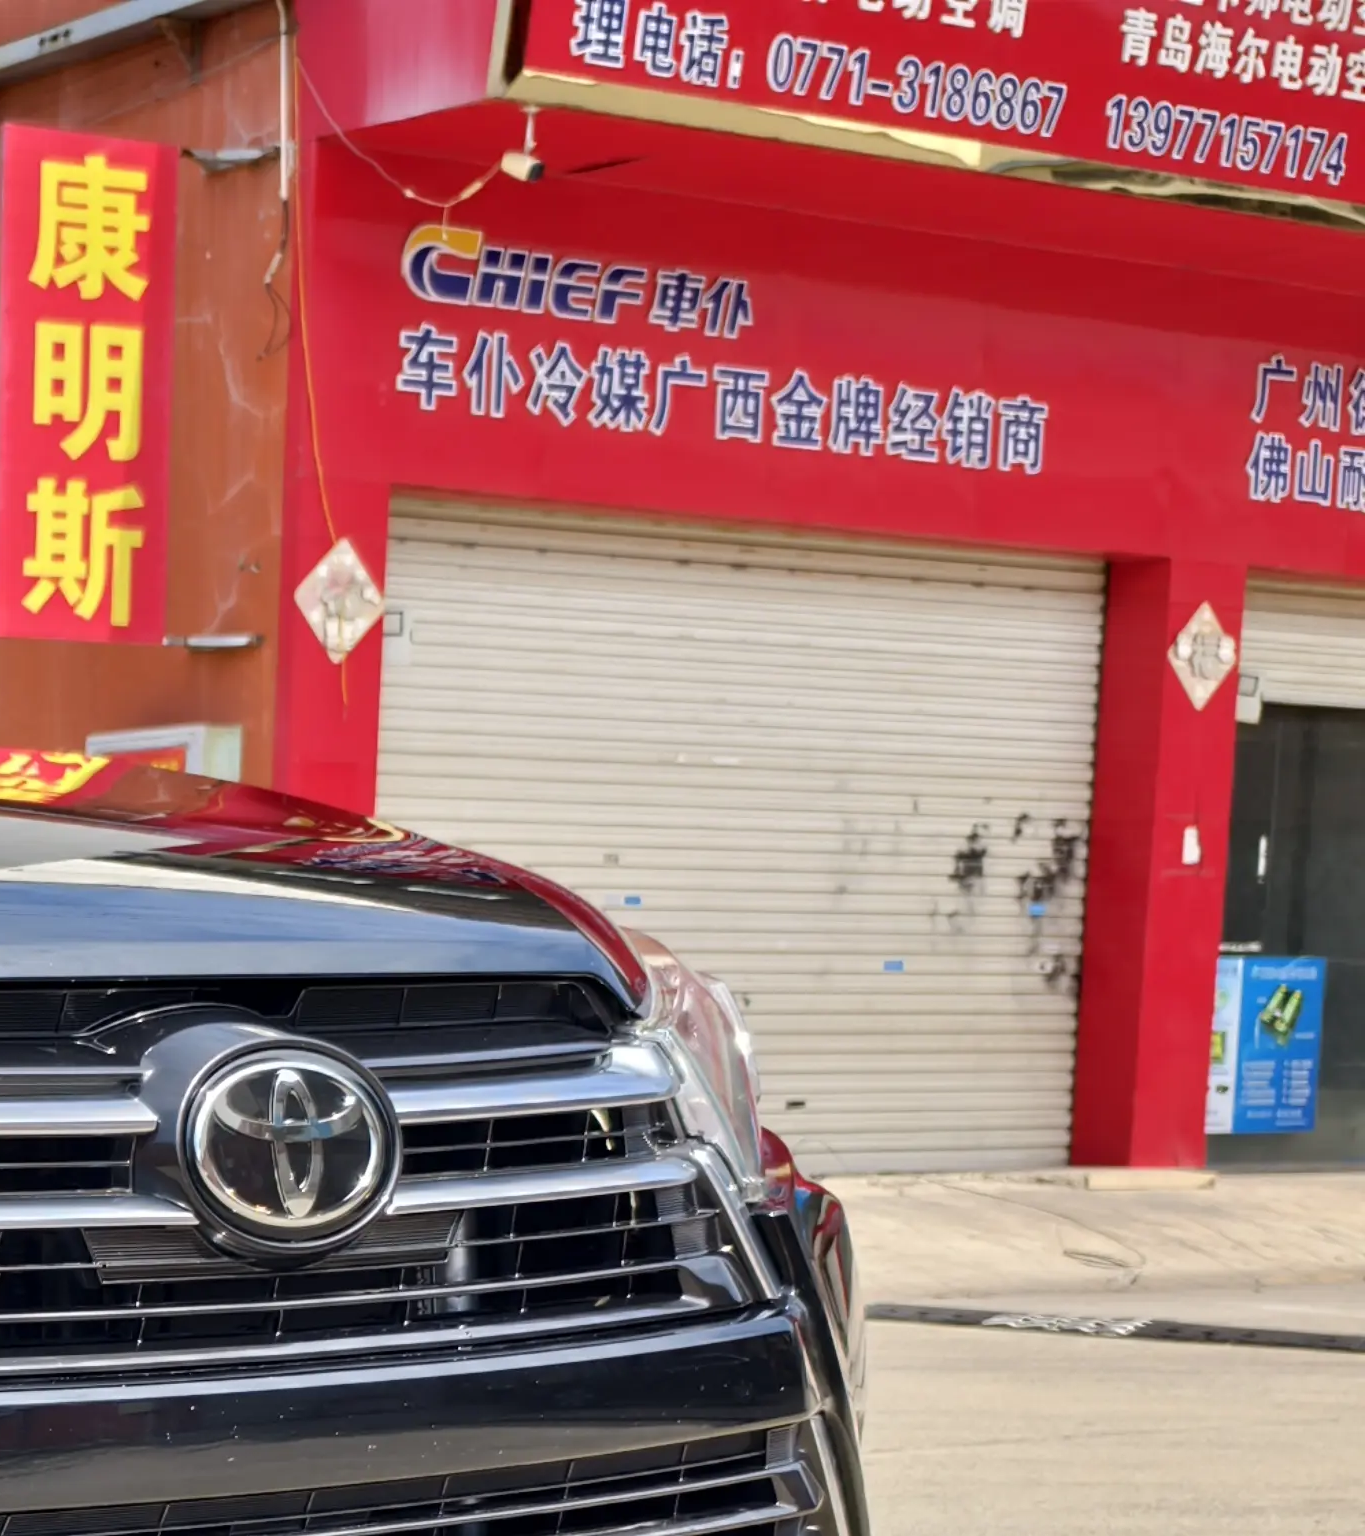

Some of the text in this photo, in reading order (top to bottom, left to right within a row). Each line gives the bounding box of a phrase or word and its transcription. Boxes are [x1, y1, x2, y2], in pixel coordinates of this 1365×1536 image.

[766, 33, 1067, 138] 0771-3186867
[1106, 93, 1349, 186] 13977157174
[401, 224, 648, 324] CHIEF
[22, 155, 150, 627] 康明斯
[396, 322, 1048, 475] 车仆冷媒广西金牌经销商
